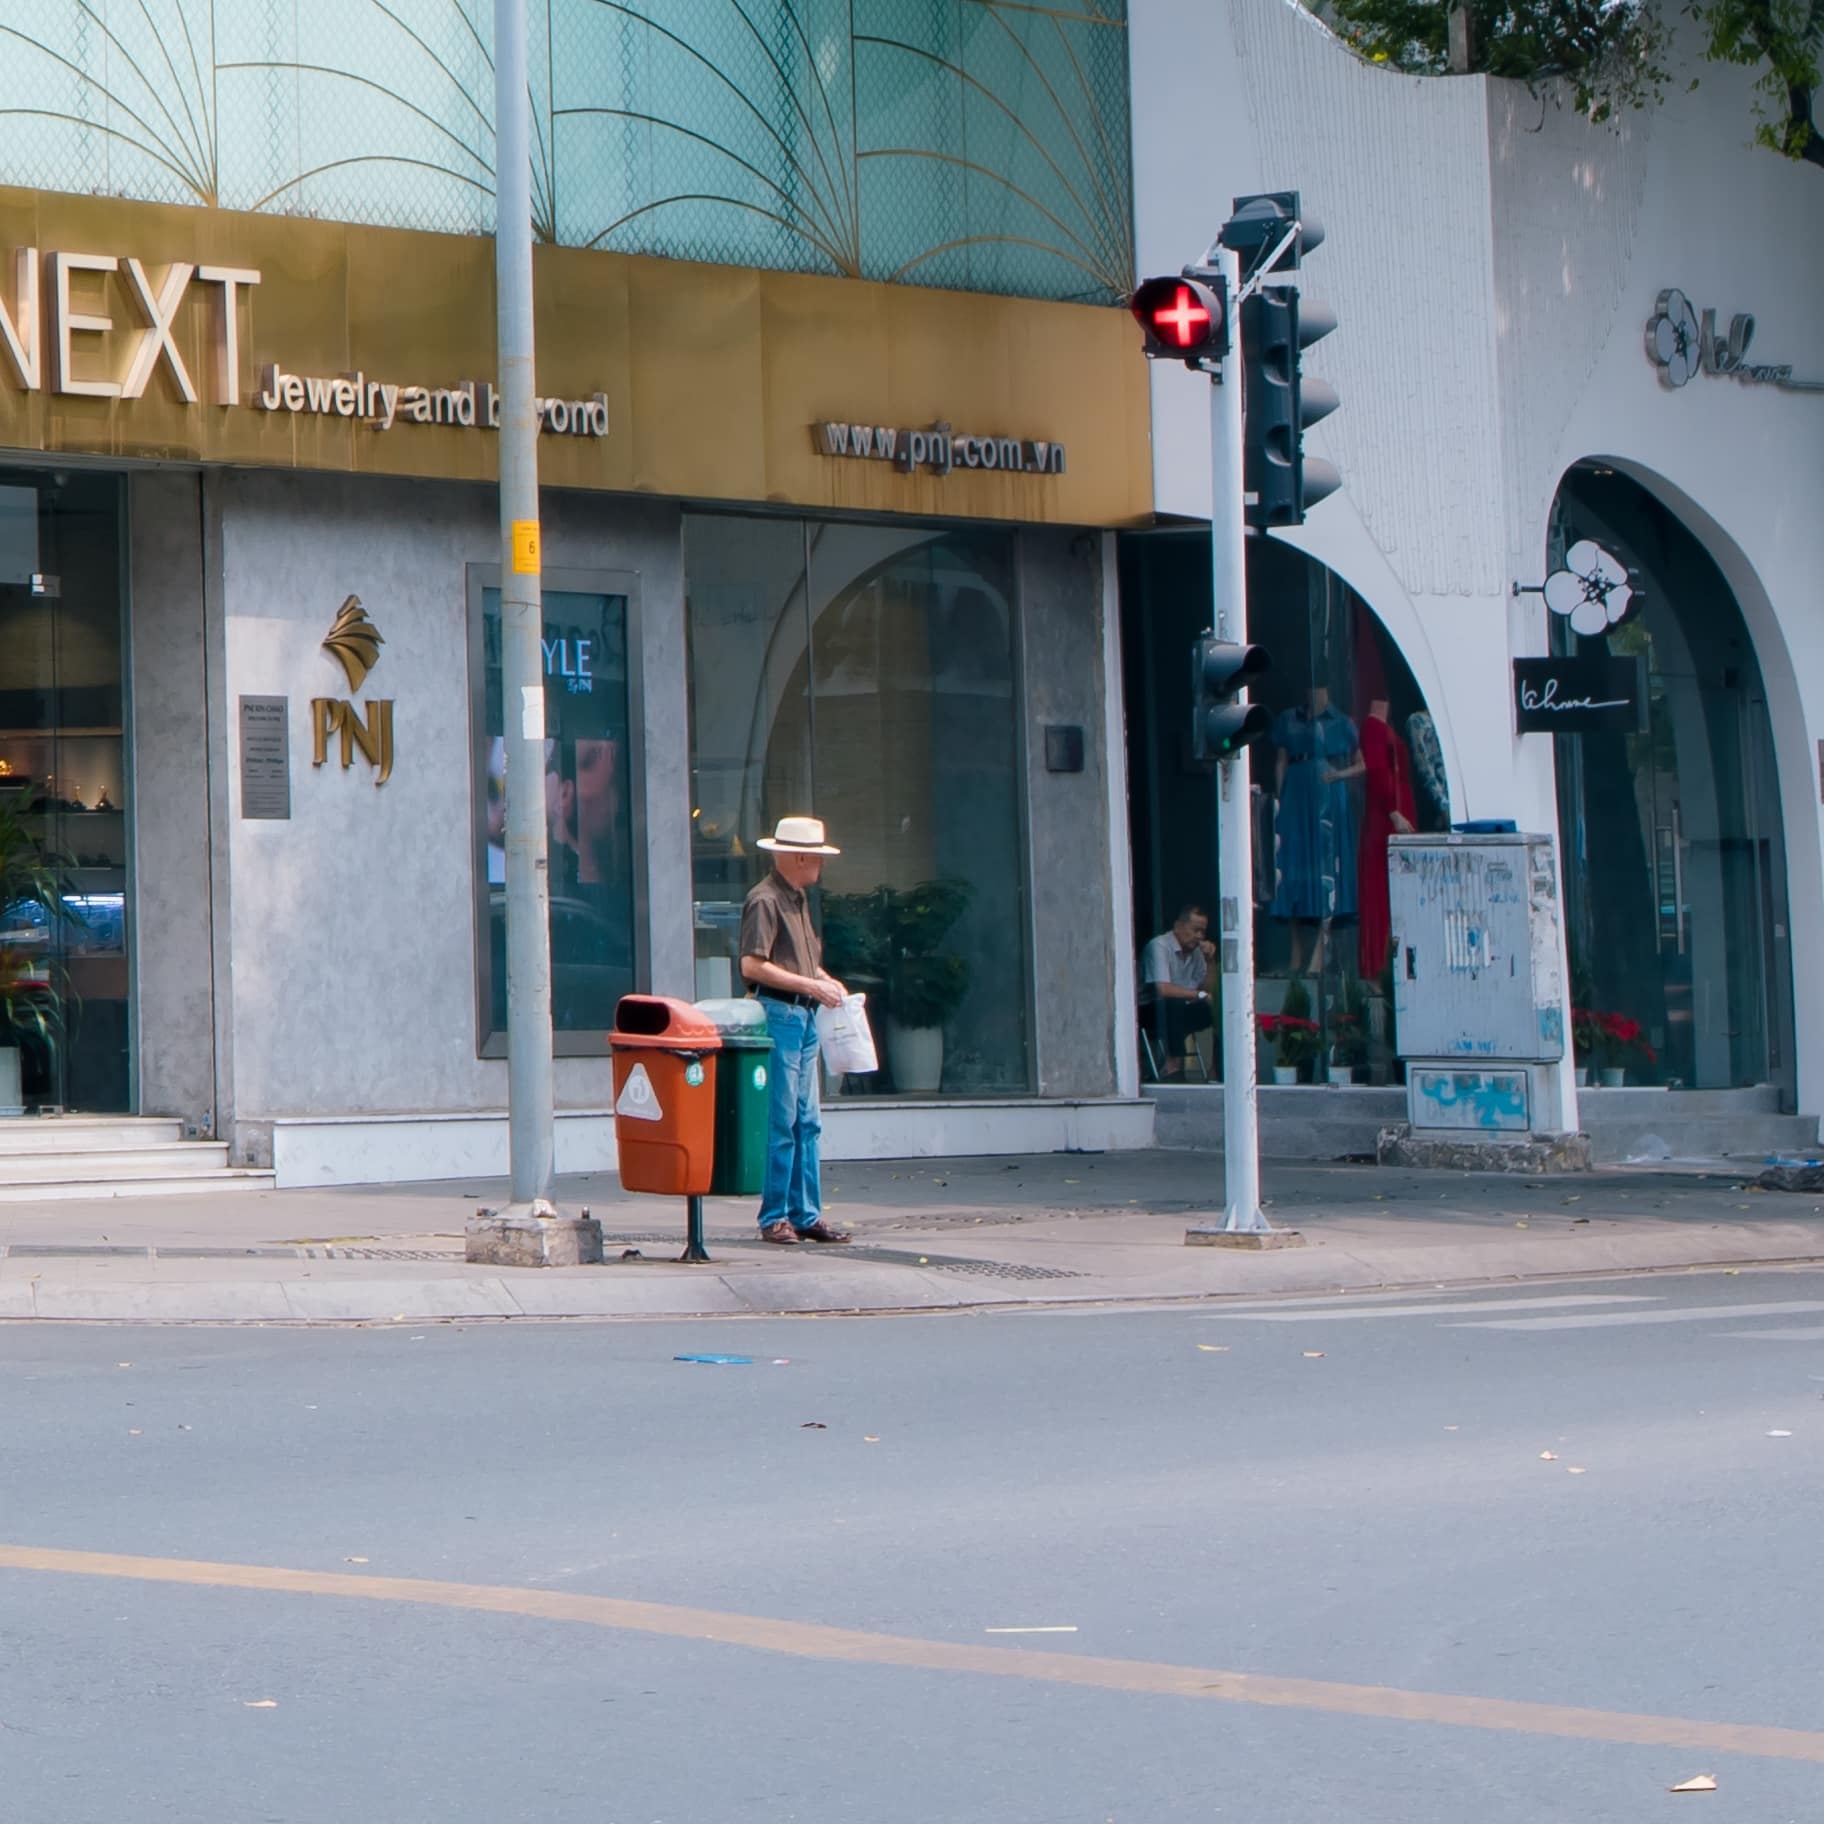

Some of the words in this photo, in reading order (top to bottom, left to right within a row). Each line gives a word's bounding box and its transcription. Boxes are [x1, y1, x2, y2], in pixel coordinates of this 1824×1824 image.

[259, 364, 398, 430] Jewelry
[410, 380, 477, 428] and
[488, 381, 610, 437] bond
[822, 421, 1068, 476] www.pnj.com.vn
[528, 541, 536, 554] 6
[541, 638, 592, 676] YLE
[311, 698, 394, 786] PNJ
